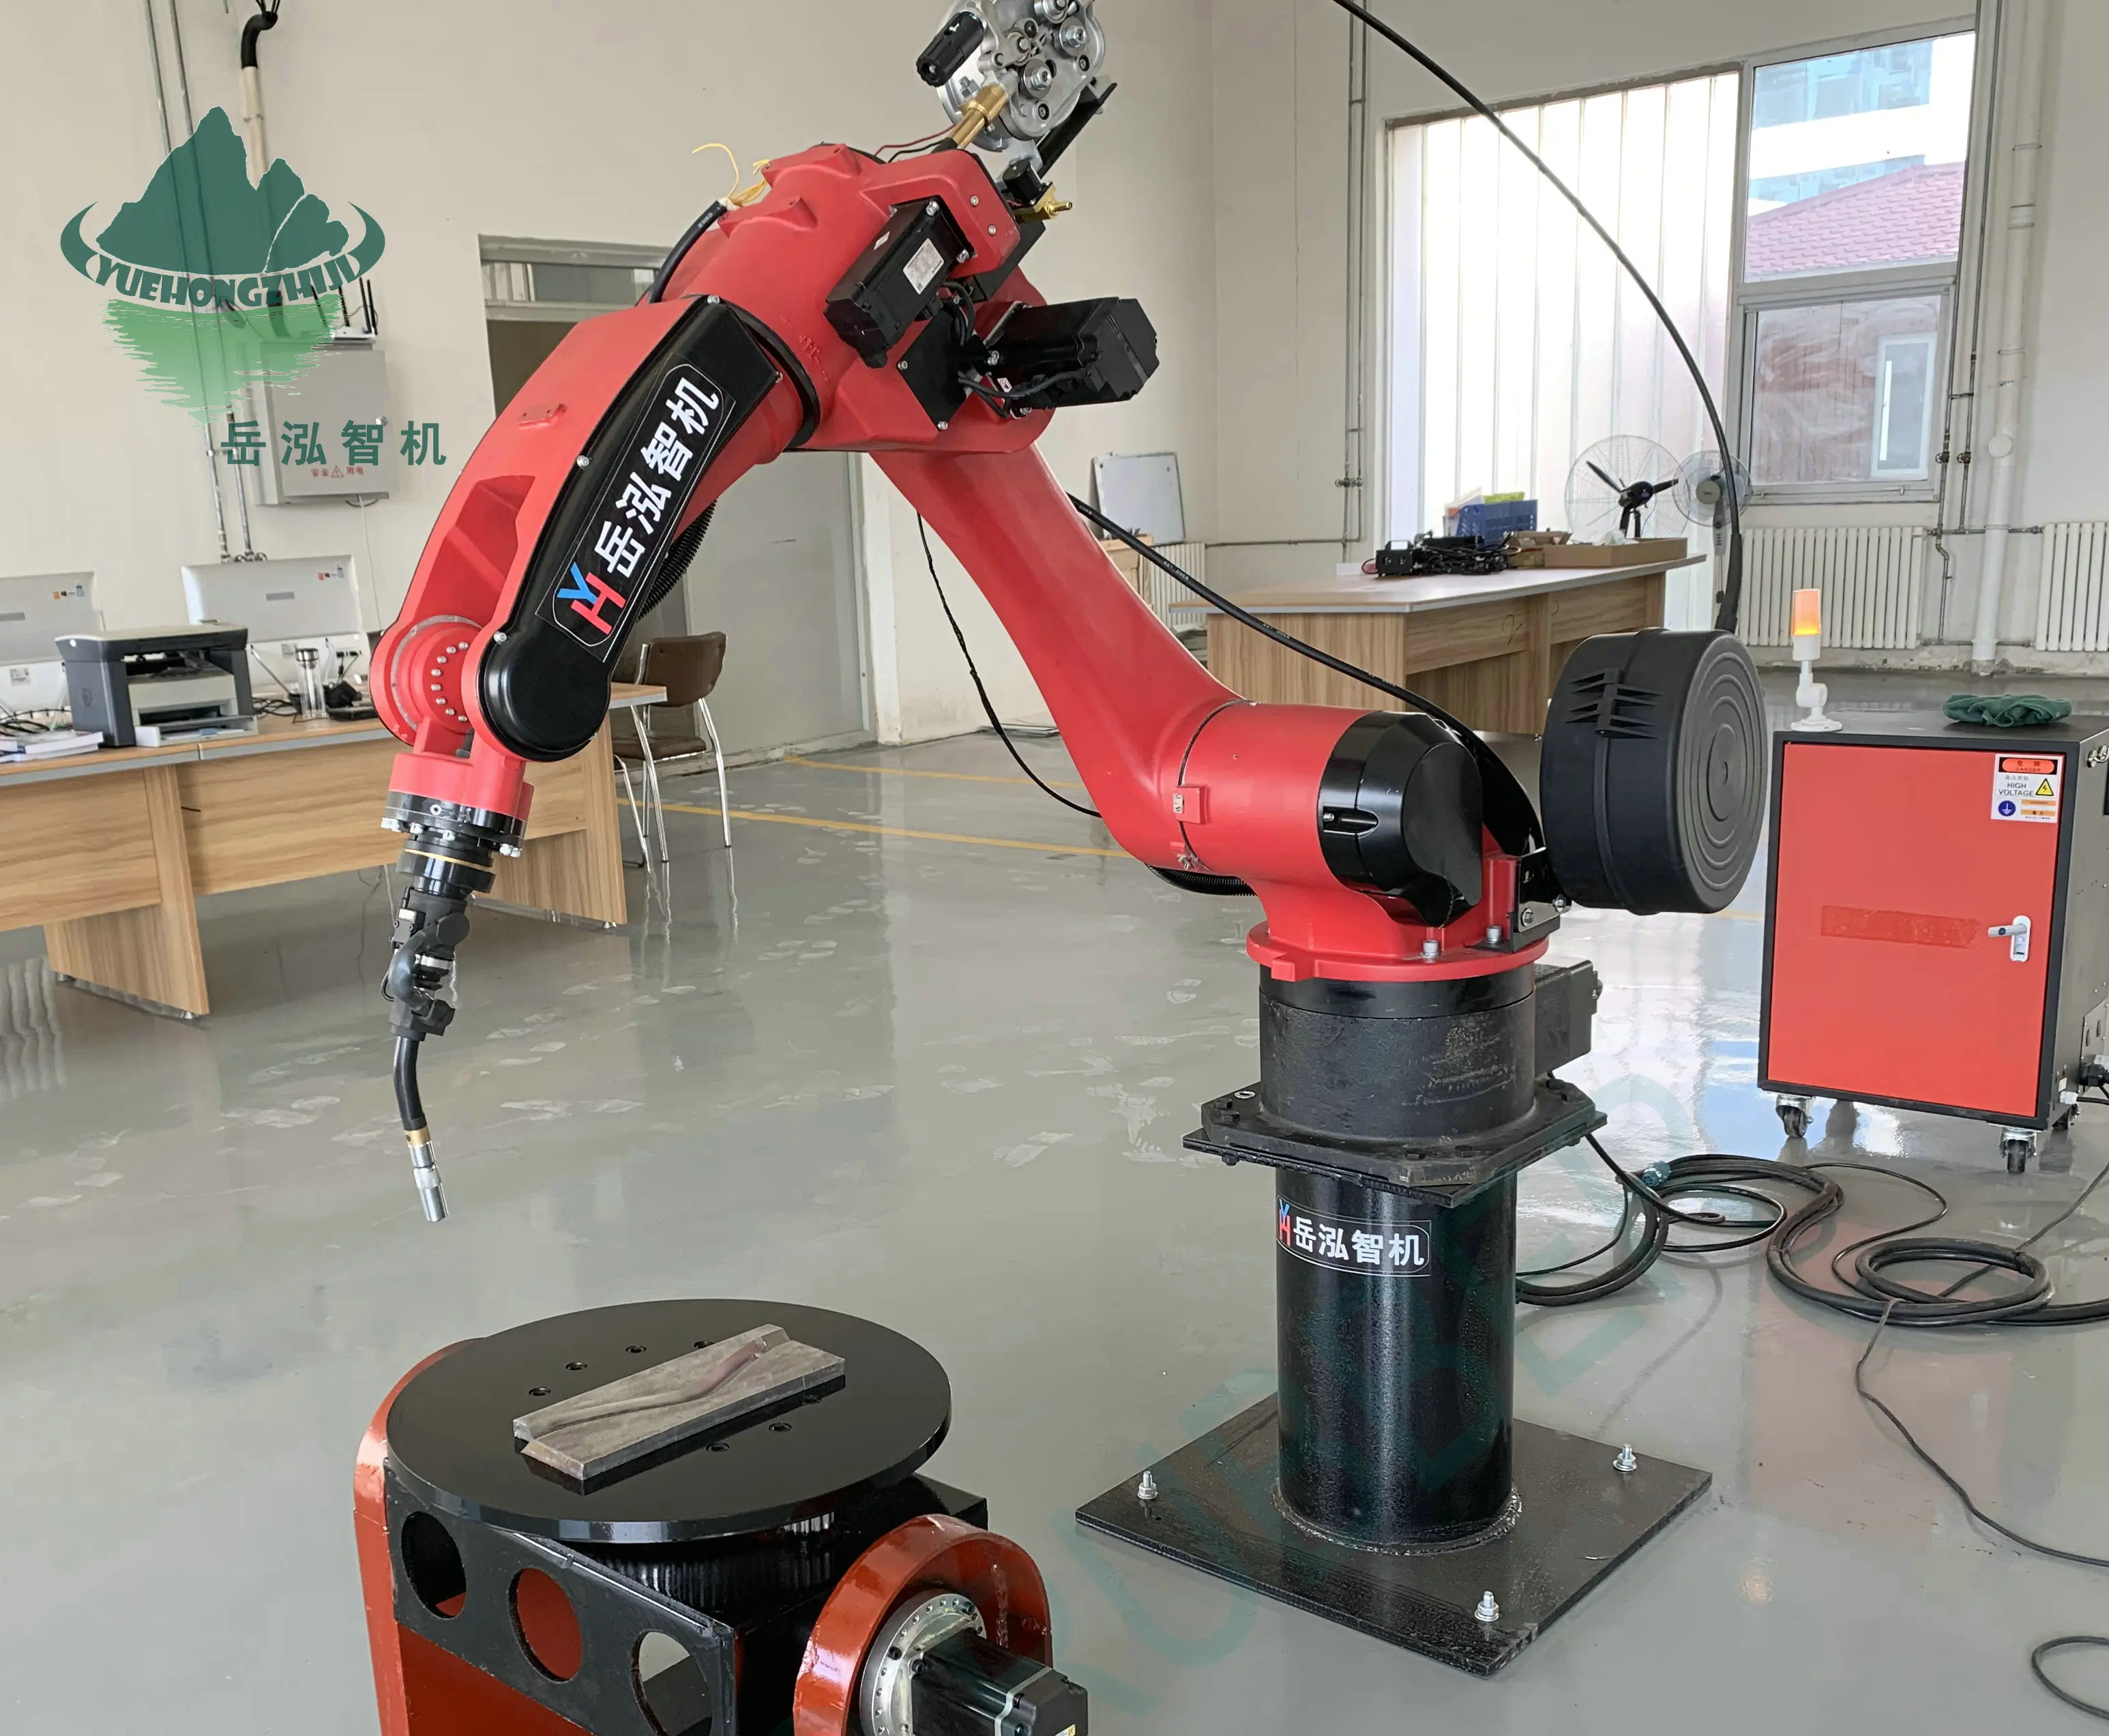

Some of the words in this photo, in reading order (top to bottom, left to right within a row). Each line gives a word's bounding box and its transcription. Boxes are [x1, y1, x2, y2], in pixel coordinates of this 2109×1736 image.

[593, 377, 720, 578] 岳泓智机
[1293, 1216, 1425, 1267] 岳泓智机
